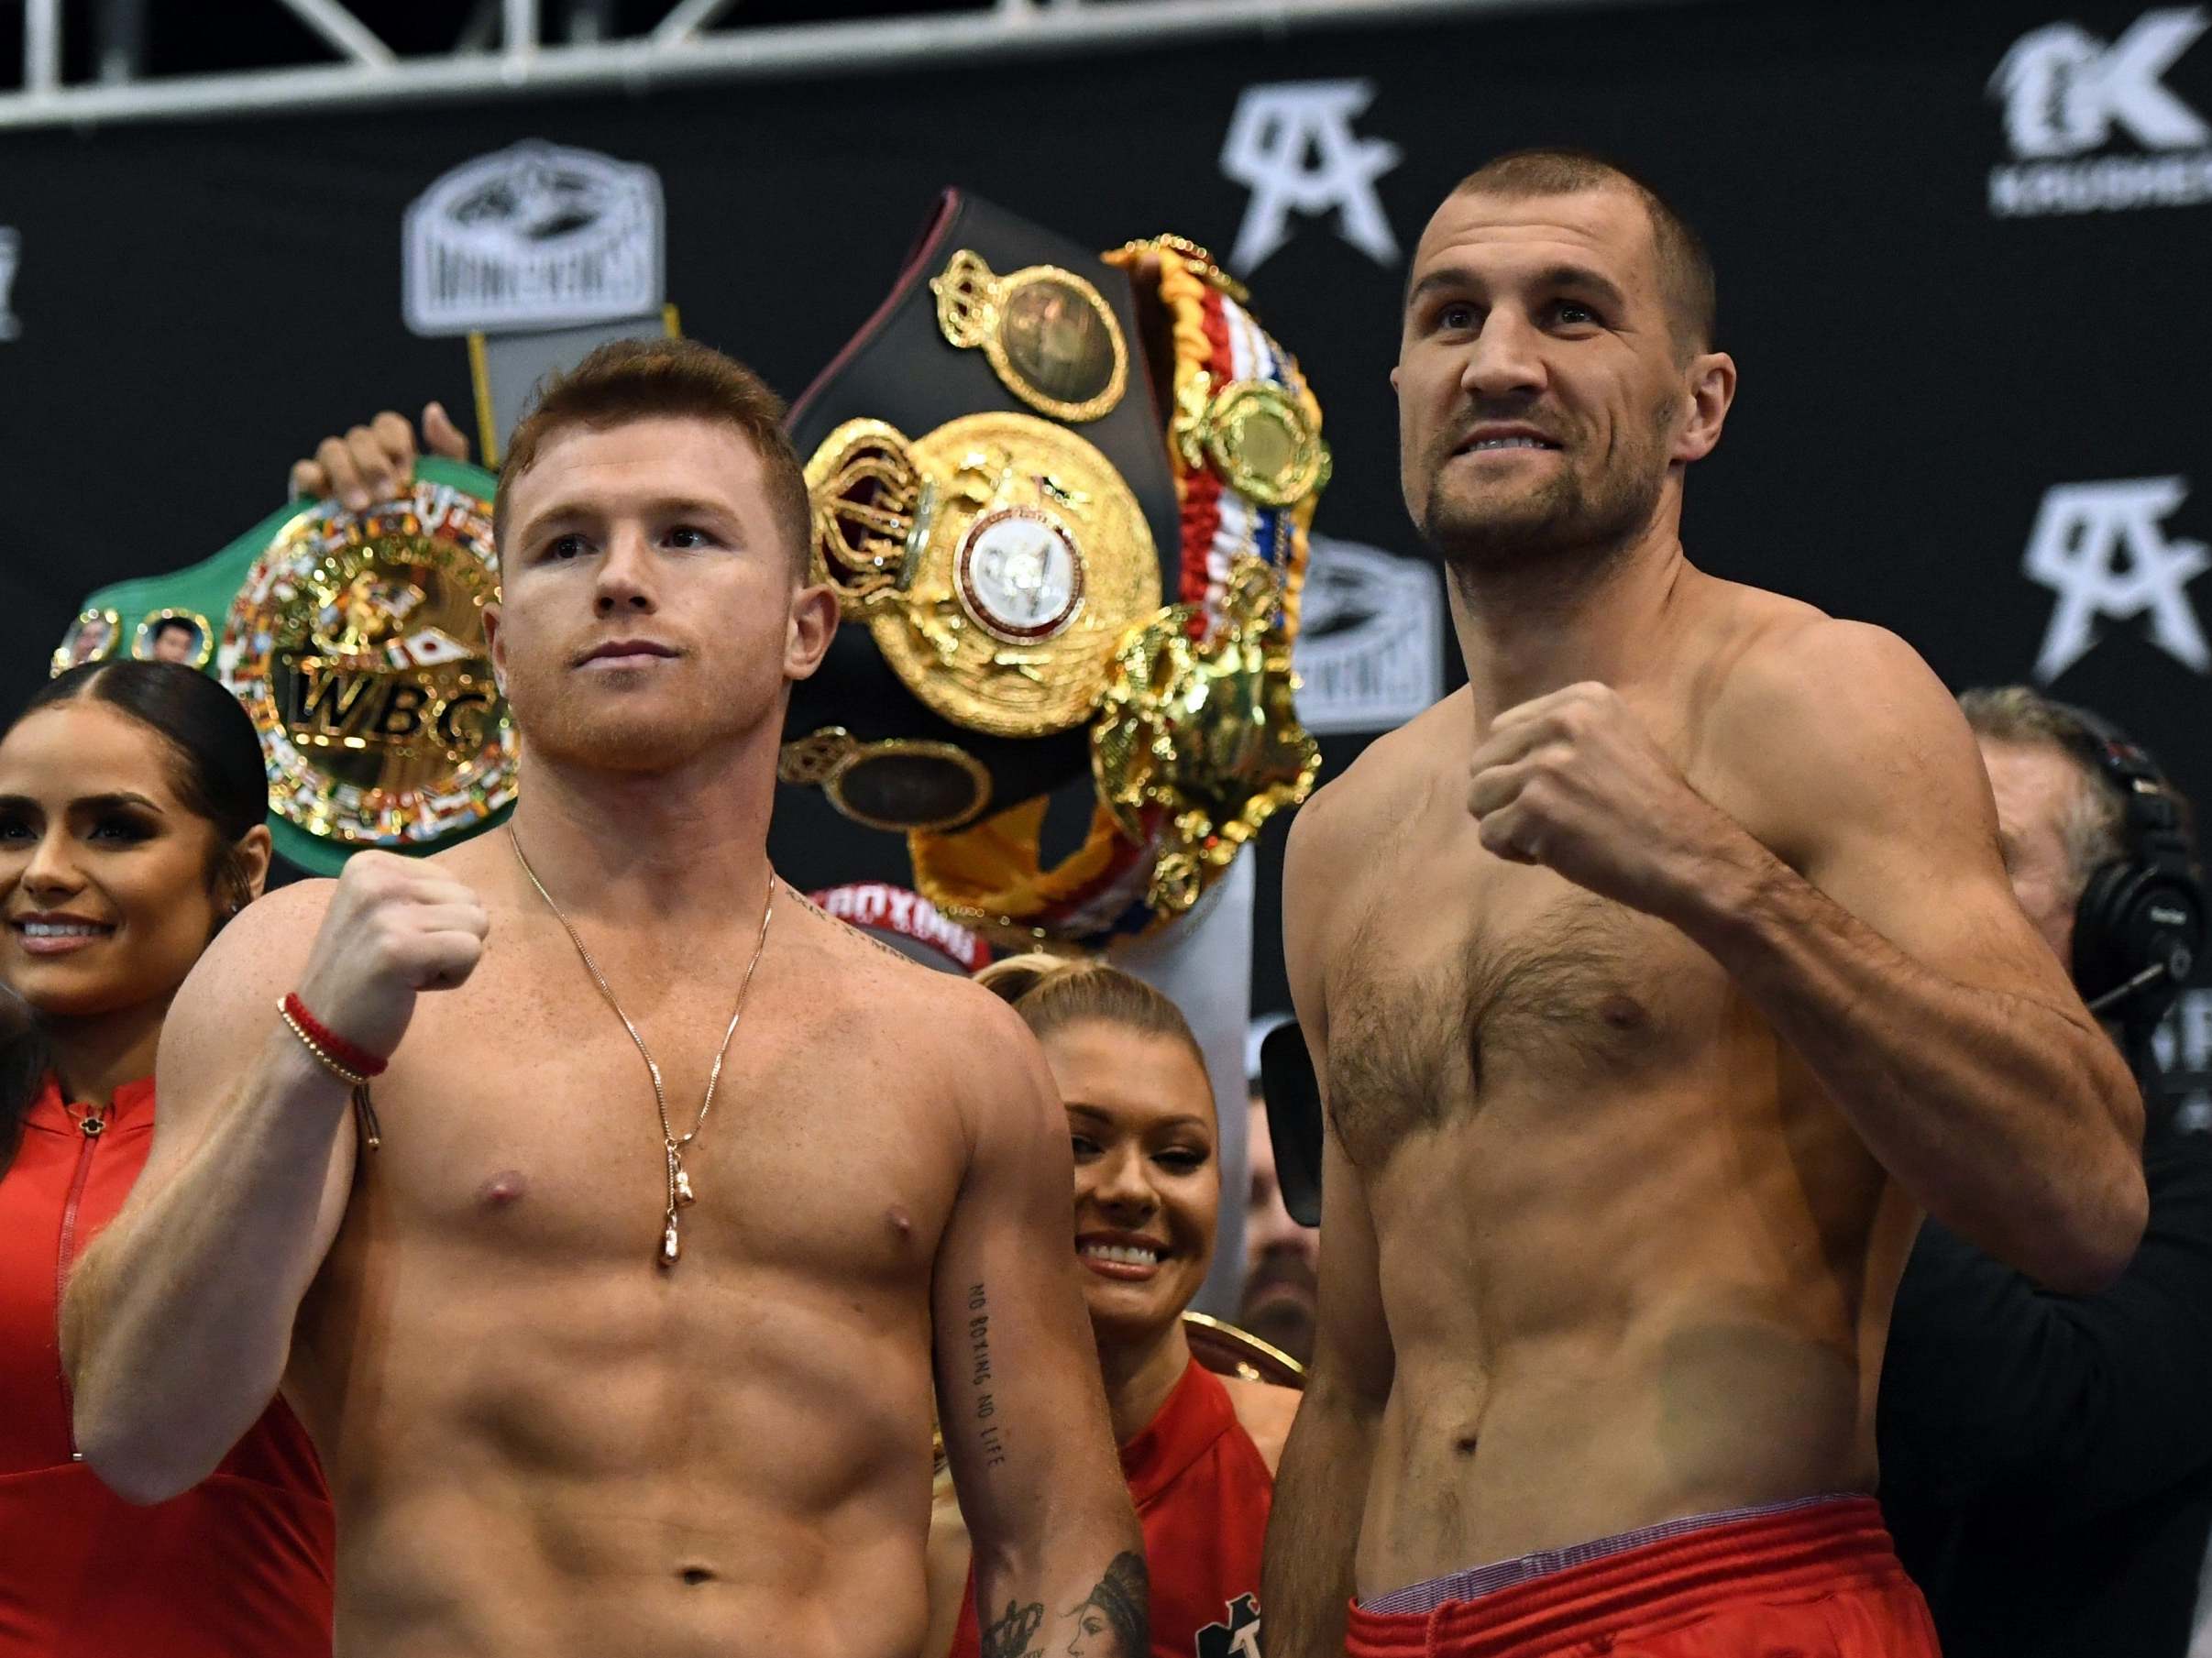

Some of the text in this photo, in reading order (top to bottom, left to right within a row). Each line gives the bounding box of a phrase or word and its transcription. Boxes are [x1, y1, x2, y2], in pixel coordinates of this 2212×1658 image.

[289, 670, 496, 747] WBC
[968, 1283, 1006, 1468] NO BOXING NO LIFE
